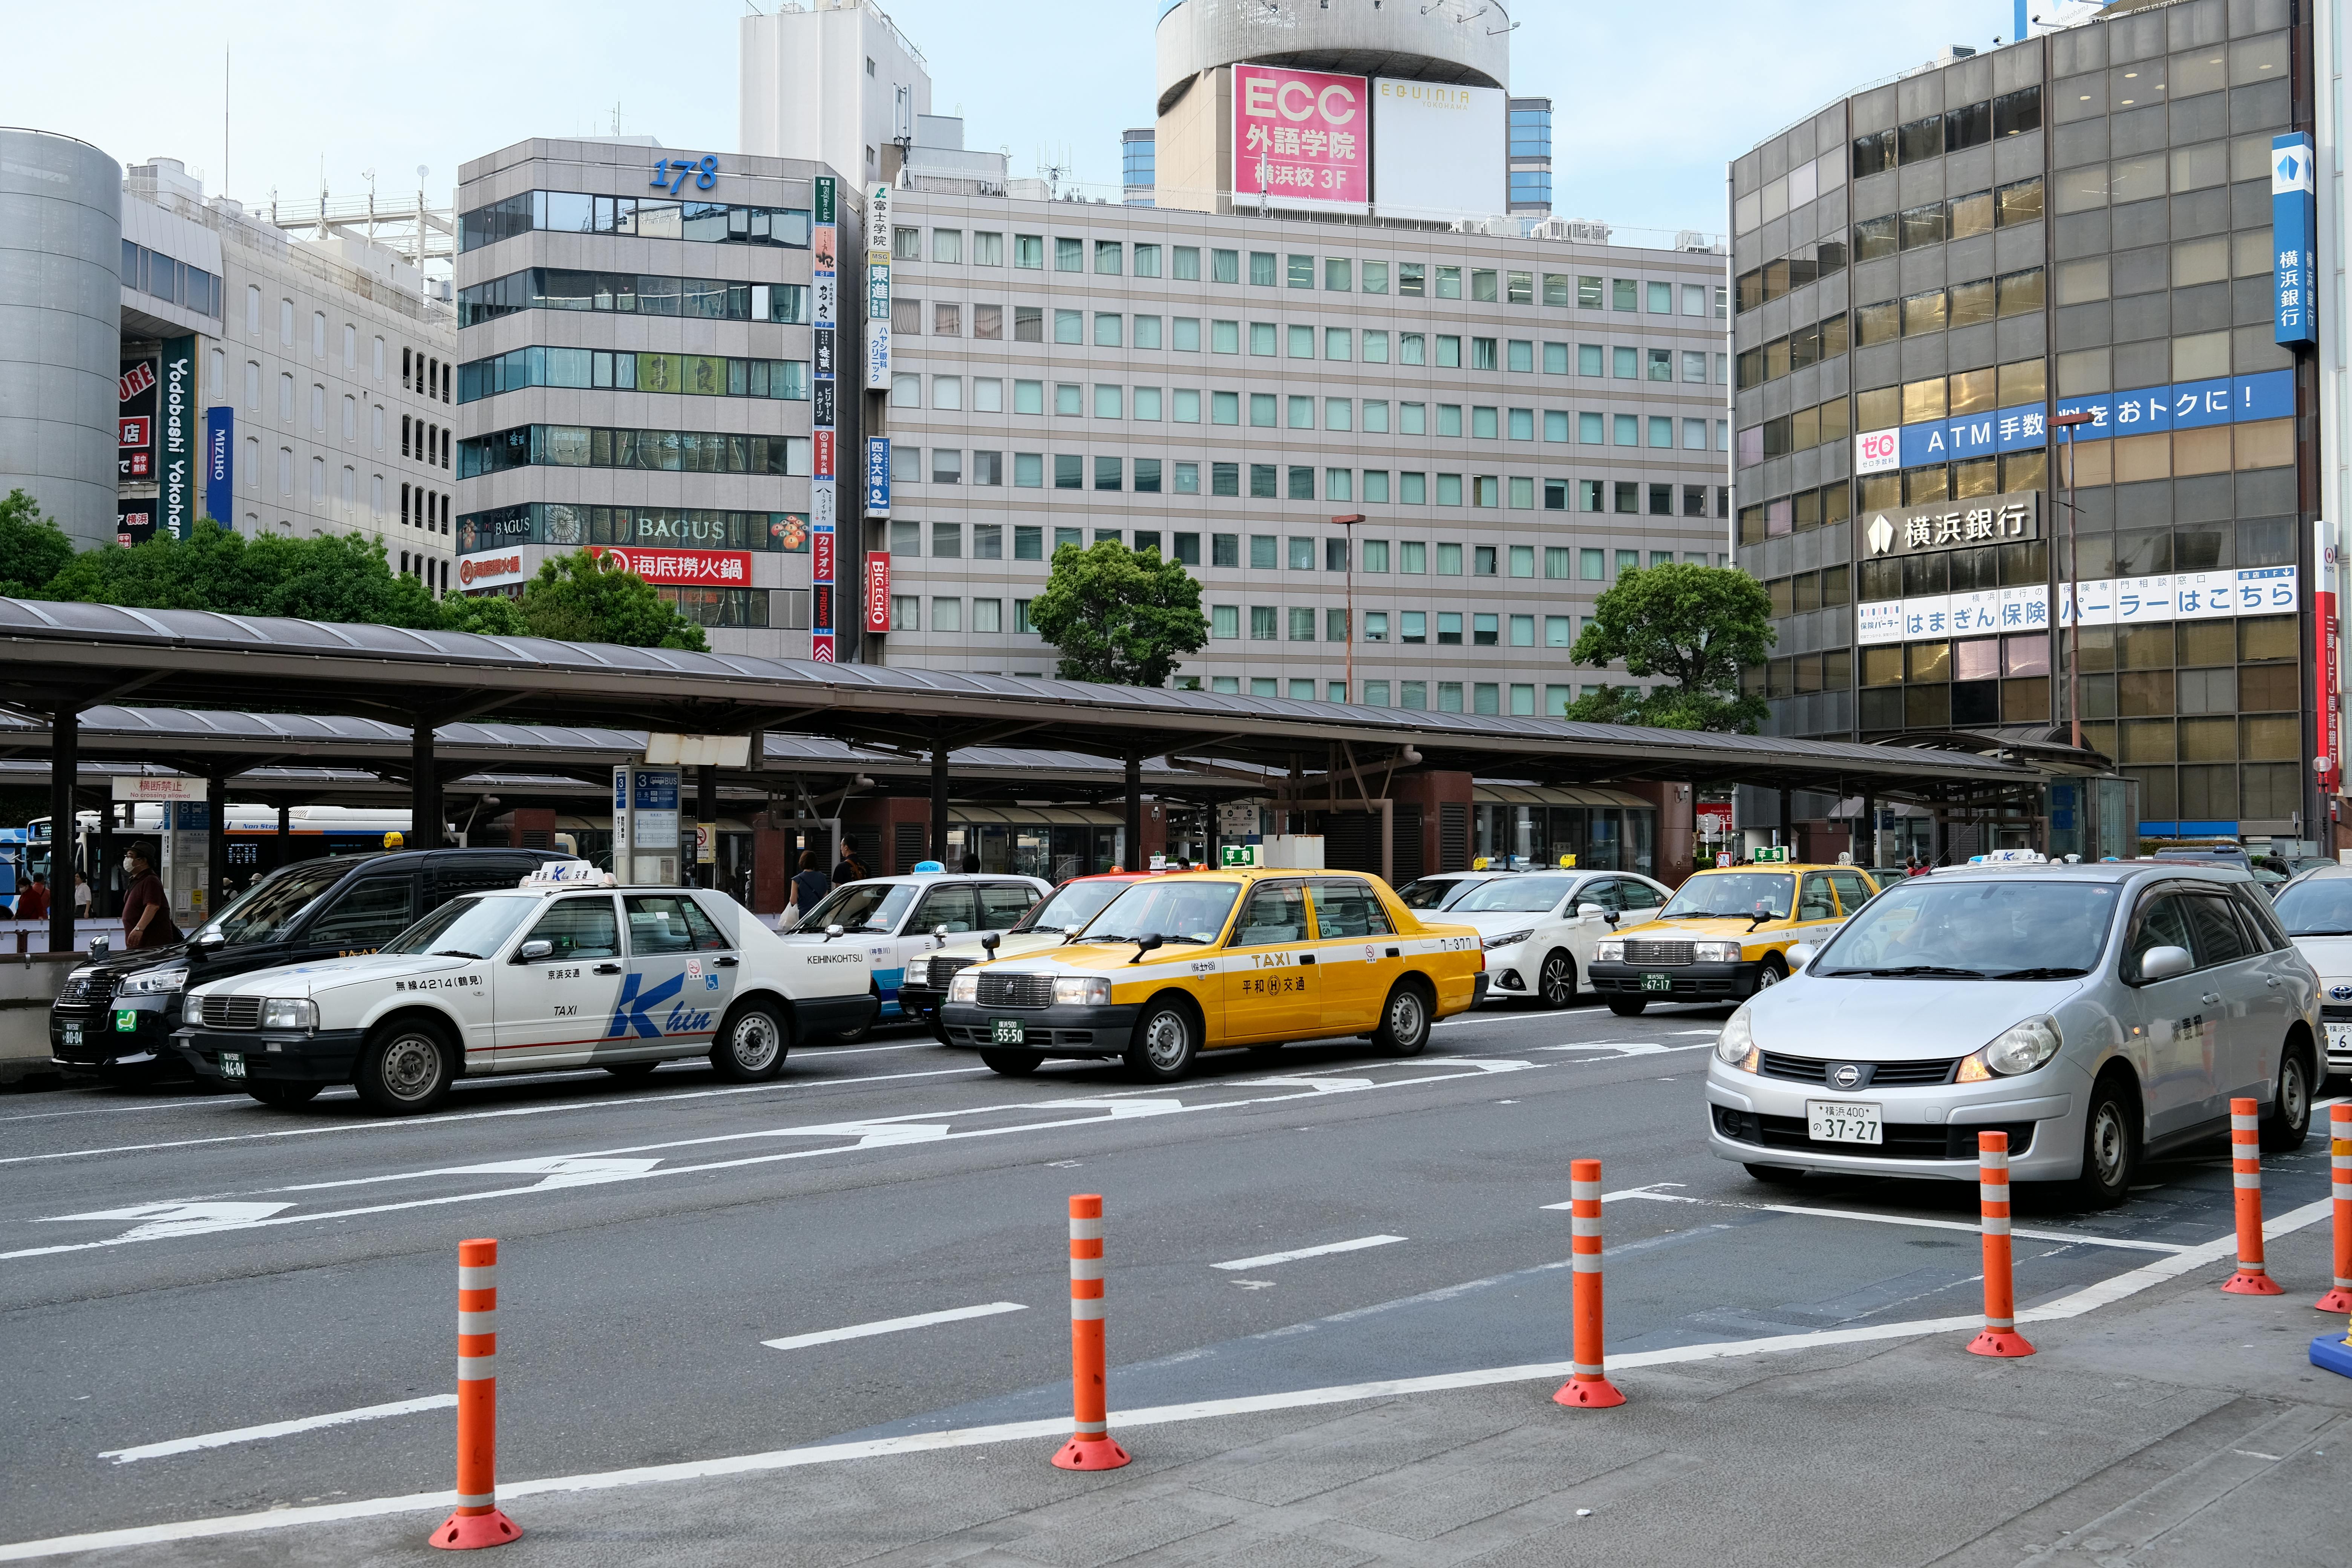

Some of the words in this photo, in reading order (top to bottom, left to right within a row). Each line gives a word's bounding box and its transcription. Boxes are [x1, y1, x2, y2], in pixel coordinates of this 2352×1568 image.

[2060, 5, 2089, 23] Yokohama
[1245, 77, 1355, 125] ECC
[1381, 83, 1470, 104] EQUINIA
[1421, 100, 1468, 111] YOKOHAMA
[1246, 124, 1355, 160] 外語学院
[650, 155, 718, 194] 178
[1254, 163, 1314, 188] 横浜校
[1321, 169, 1347, 190] 3F
[873, 200, 887, 246] 富士学院
[872, 266, 888, 299] 東進
[2280, 250, 2300, 327] 横浜銀行
[879, 327, 888, 369] ハヤシ眼科
[168, 358, 188, 453] Yodobashi
[134, 455, 146, 463] 年中
[214, 429, 225, 480] MIZUHO
[1862, 456, 1894, 468] ゼロ手数料
[133, 464, 147, 472] 無休
[871, 441, 883, 487] 四谷大塚
[127, 513, 148, 525] 横浜
[496, 517, 530, 535] BAGUS
[1905, 504, 2026, 548] 横浜銀行
[638, 518, 724, 539] BAGUS
[818, 536, 829, 578] カラオケ
[474, 556, 520, 578] 海底撈火鍋
[632, 555, 743, 580] 海底撈火鍋
[872, 561, 884, 585] BIG
[872, 588, 884, 624] ECHO
[1860, 620, 1899, 630] 保険パーラー
[139, 780, 182, 791] 横断禁止
[619, 779, 623, 787] 3
[639, 775, 646, 787] 3
[165, 802, 169, 813] 8
[181, 802, 188, 813] 8
[1227, 850, 1250, 862] 平和
[1758, 850, 1779, 859] 平和
[534, 872, 548, 880] 京浜
[574, 871, 588, 879] 交通
[1440, 938, 1472, 951] 7-377
[1251, 952, 1290, 968] TAXI
[548, 968, 580, 980] 京浜交通
[1243, 979, 1264, 994] 平和
[1284, 977, 1305, 991] 交通
[1647, 980, 1670, 989] 67-17
[554, 1005, 577, 1016] TAXI
[66, 1031, 82, 1044] 80-04
[998, 1029, 1023, 1042] 55-50
[226, 1062, 245, 1076] 46-04
[1825, 1106, 1864, 1117] 横浜400
[1813, 1123, 1822, 1132] の
[1825, 1119, 1877, 1141] 37-27
